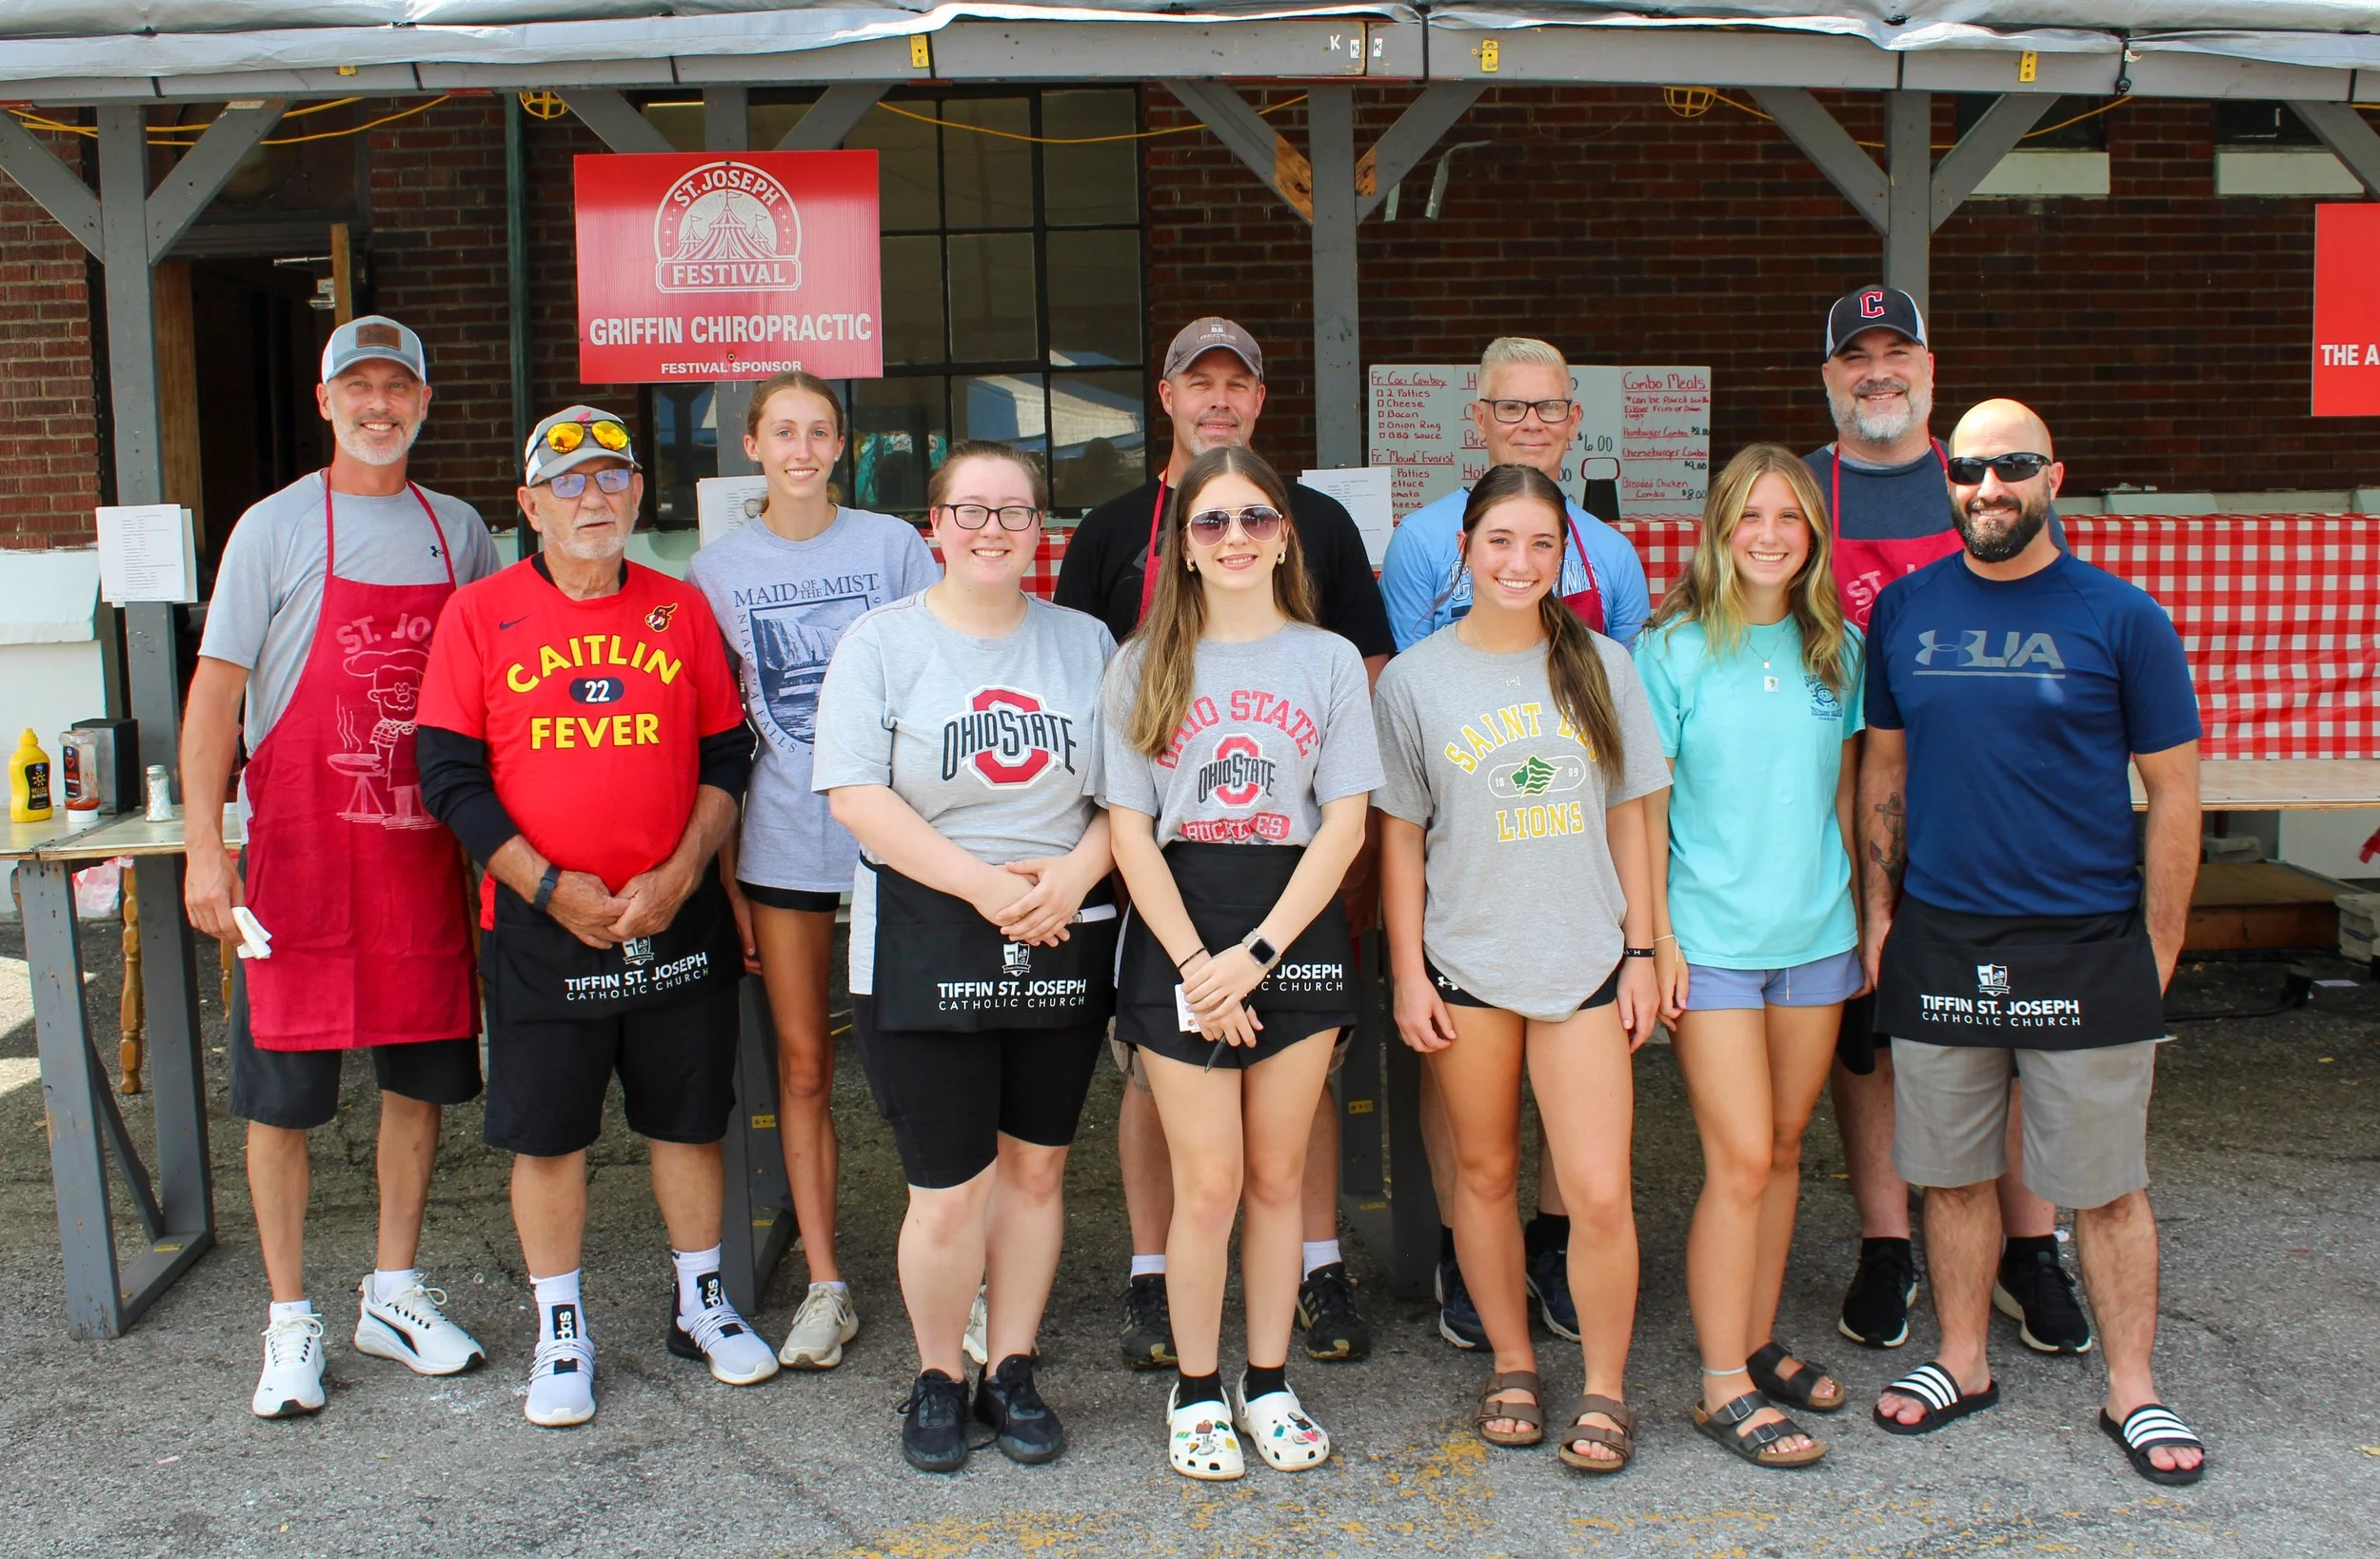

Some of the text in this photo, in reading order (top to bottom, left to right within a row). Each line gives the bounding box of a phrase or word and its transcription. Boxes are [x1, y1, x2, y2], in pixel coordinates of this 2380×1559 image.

[673, 169, 782, 207] ST. JOSEPH
[673, 264, 786, 286] FESTIVAL
[1860, 291, 1885, 319] C
[589, 313, 872, 345] GRIFFIN CHIROPRACTIC
[2321, 344, 2359, 366] THE
[661, 361, 802, 374] FESTIVAL SPONSOR
[1413, 372, 1446, 388] Cowboy
[1623, 371, 1706, 390] Combo Meals
[1398, 389, 1430, 398] Patties
[1420, 420, 1440, 431] Ring
[1398, 468, 1430, 478] Patties
[1656, 478, 1688, 487] Chicken
[733, 582, 798, 607] MAID
[799, 588, 823, 600] THE
[802, 580, 818, 590] OF
[336, 615, 382, 654] ST.
[506, 634, 683, 693] CAITLIN
[585, 680, 610, 702] 22
[530, 713, 661, 750] FEVER
[755, 709, 798, 754] FALLS
[1230, 689, 1321, 759] STATE
[1443, 702, 1542, 776] SAINT
[1496, 800, 1585, 843] LIONS
[565, 974, 620, 992] TIFFIN
[625, 969, 647, 986] ST.
[651, 952, 708, 981] JOSEPH
[1277, 964, 1342, 979] JOSEPH
[566, 968, 709, 1001] CATHOLIC CHURCH
[937, 978, 1086, 998] TIFFIN ST. JOSEPH
[1279, 982, 1343, 992] CHURCH
[939, 996, 1085, 1011] CATHOLIC CHURCH
[1920, 995, 2080, 1016] TIFFIN ST. JOSEPH
[1922, 1012, 2081, 1027] CATHOLIC CHURCH
